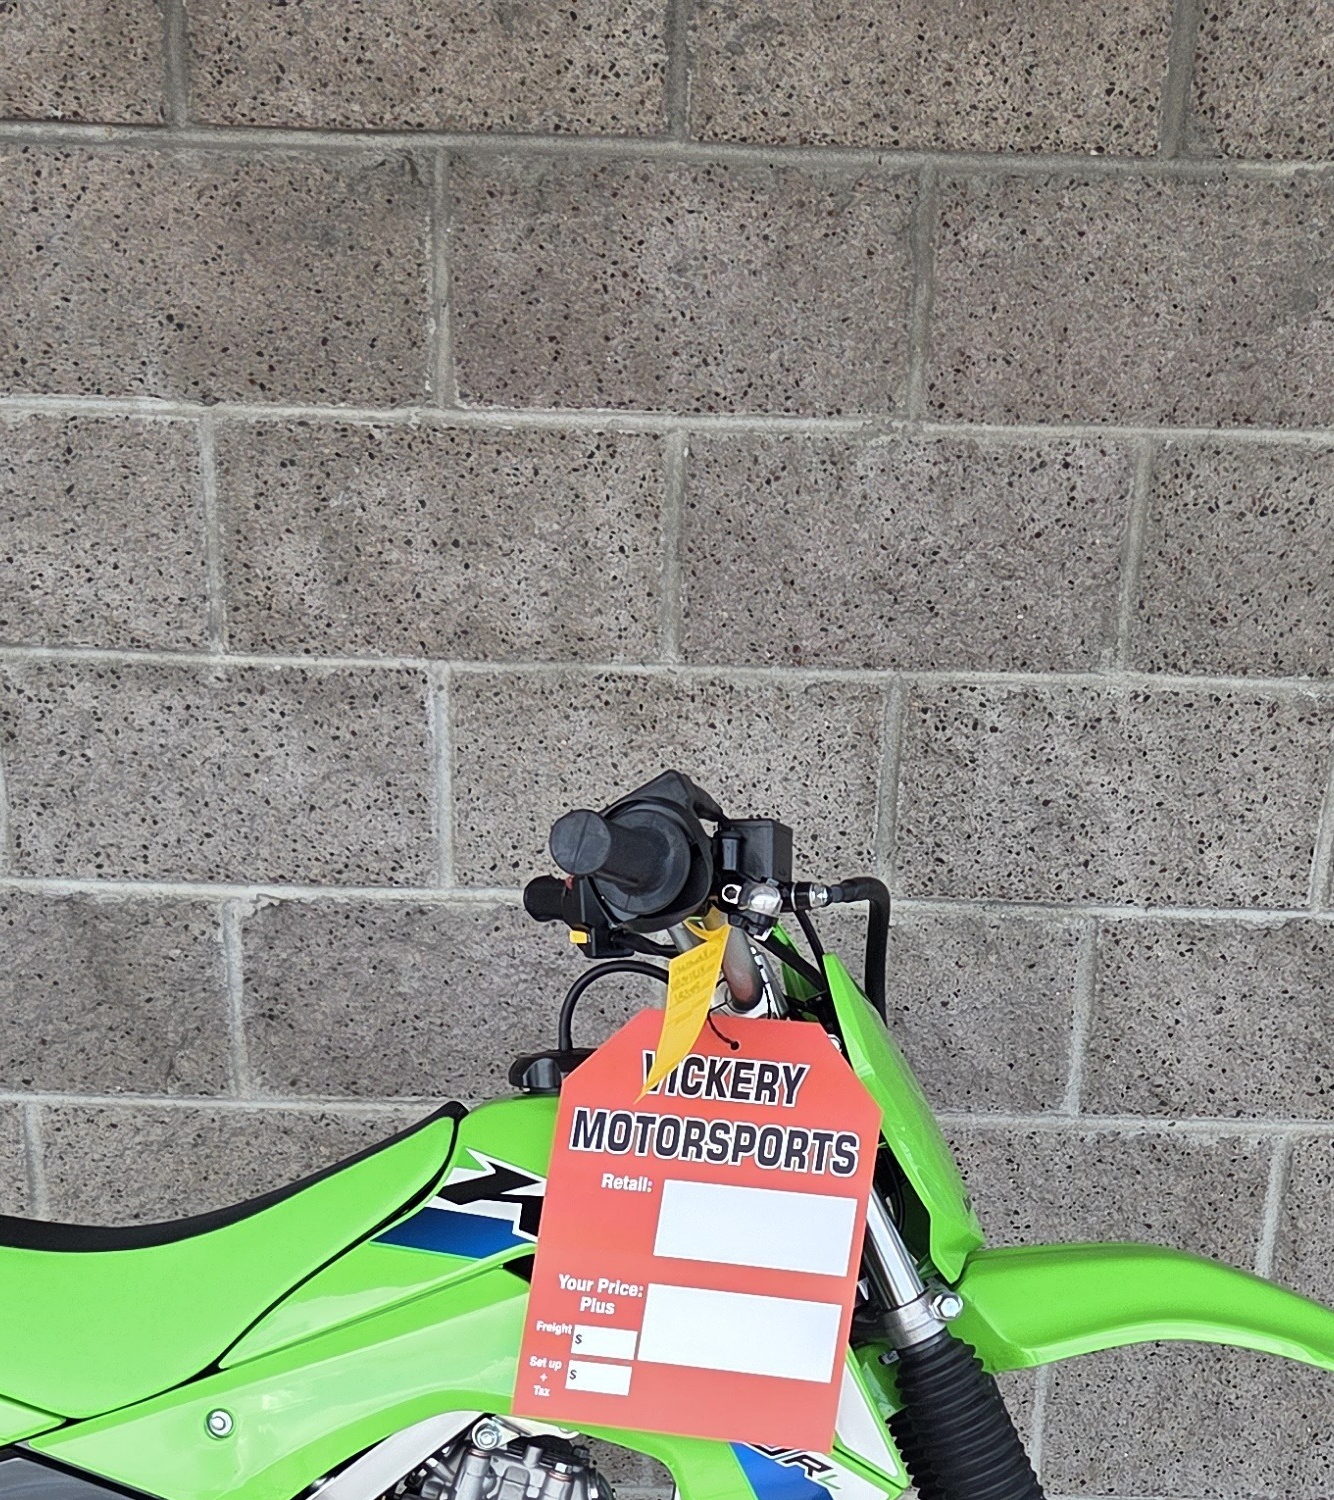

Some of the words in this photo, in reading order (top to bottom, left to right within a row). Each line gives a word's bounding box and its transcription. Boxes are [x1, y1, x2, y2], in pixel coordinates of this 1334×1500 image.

[569, 1107, 860, 1177] MOTORSPORTS
[601, 1173, 652, 1193] Retail:
[558, 1273, 594, 1292] Your
[597, 1277, 644, 1298] Price:
[579, 1296, 615, 1315] Plus
[536, 1320, 573, 1335] Freight
[529, 1355, 547, 1368] Set
[548, 1359, 563, 1372] up
